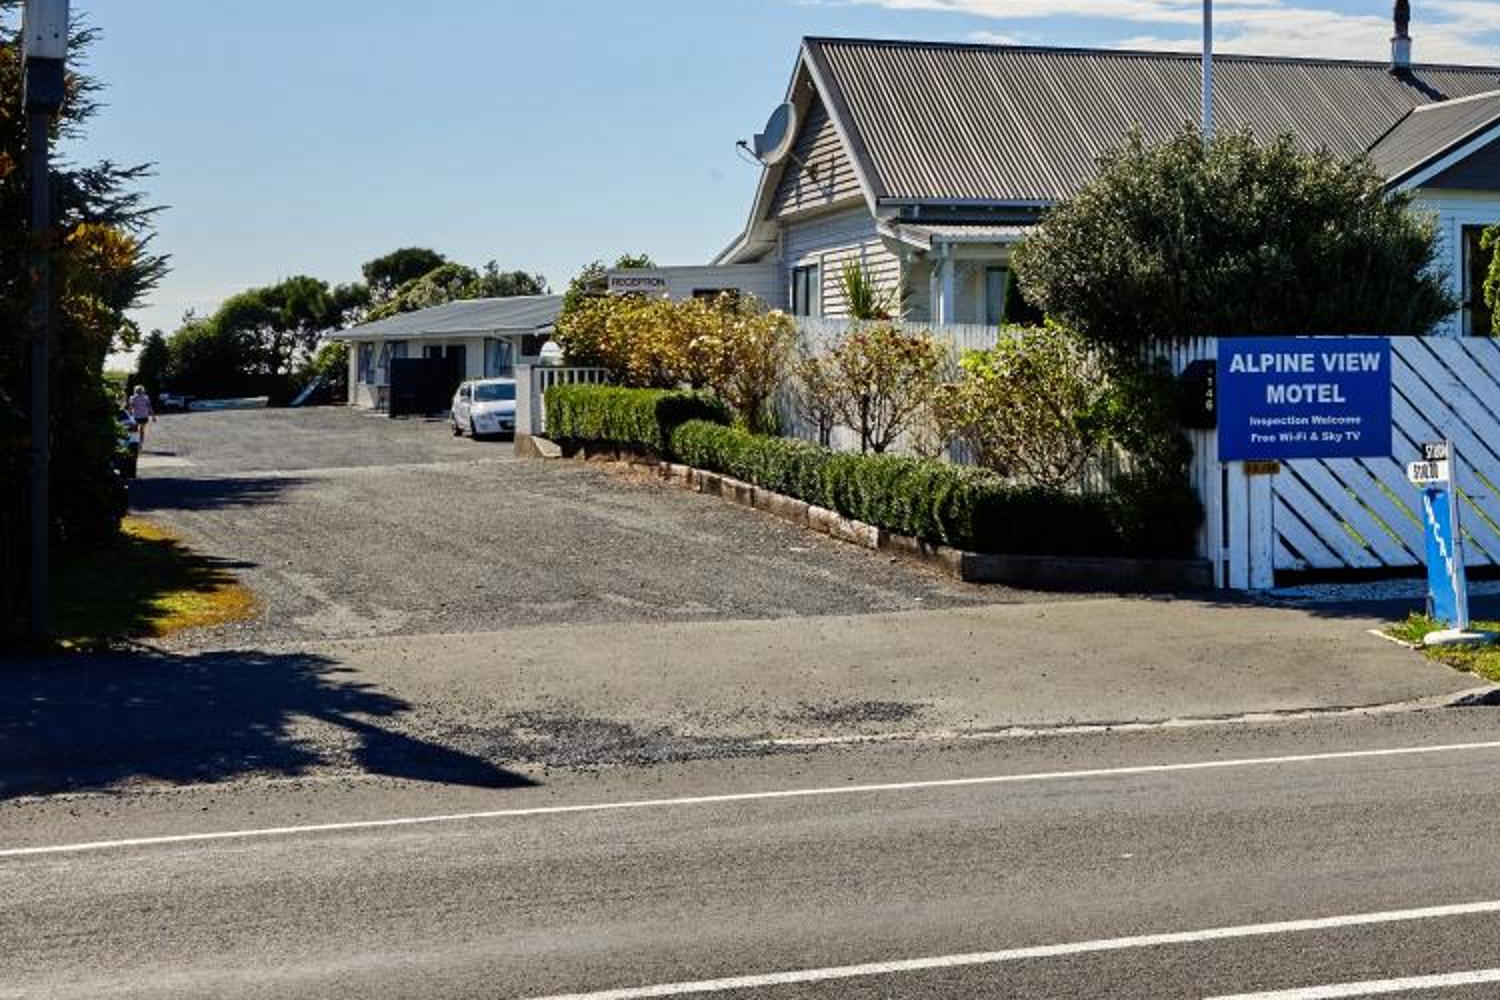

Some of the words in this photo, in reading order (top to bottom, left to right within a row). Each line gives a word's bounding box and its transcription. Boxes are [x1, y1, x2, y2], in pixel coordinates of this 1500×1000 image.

[611, 277, 665, 287] RECEPTION
[1229, 353, 1315, 373] ALPINE
[1321, 352, 1381, 372] VIEW
[1266, 383, 1346, 403] MOTEL
[1249, 415, 1309, 427] Inspection
[1311, 415, 1361, 425] Welcome
[1251, 433, 1276, 443] Free
[1279, 431, 1307, 442] Wi-Fi
[1309, 432, 1319, 441] &
[1321, 431, 1343, 443] Sky
[1345, 431, 1361, 441] TV
